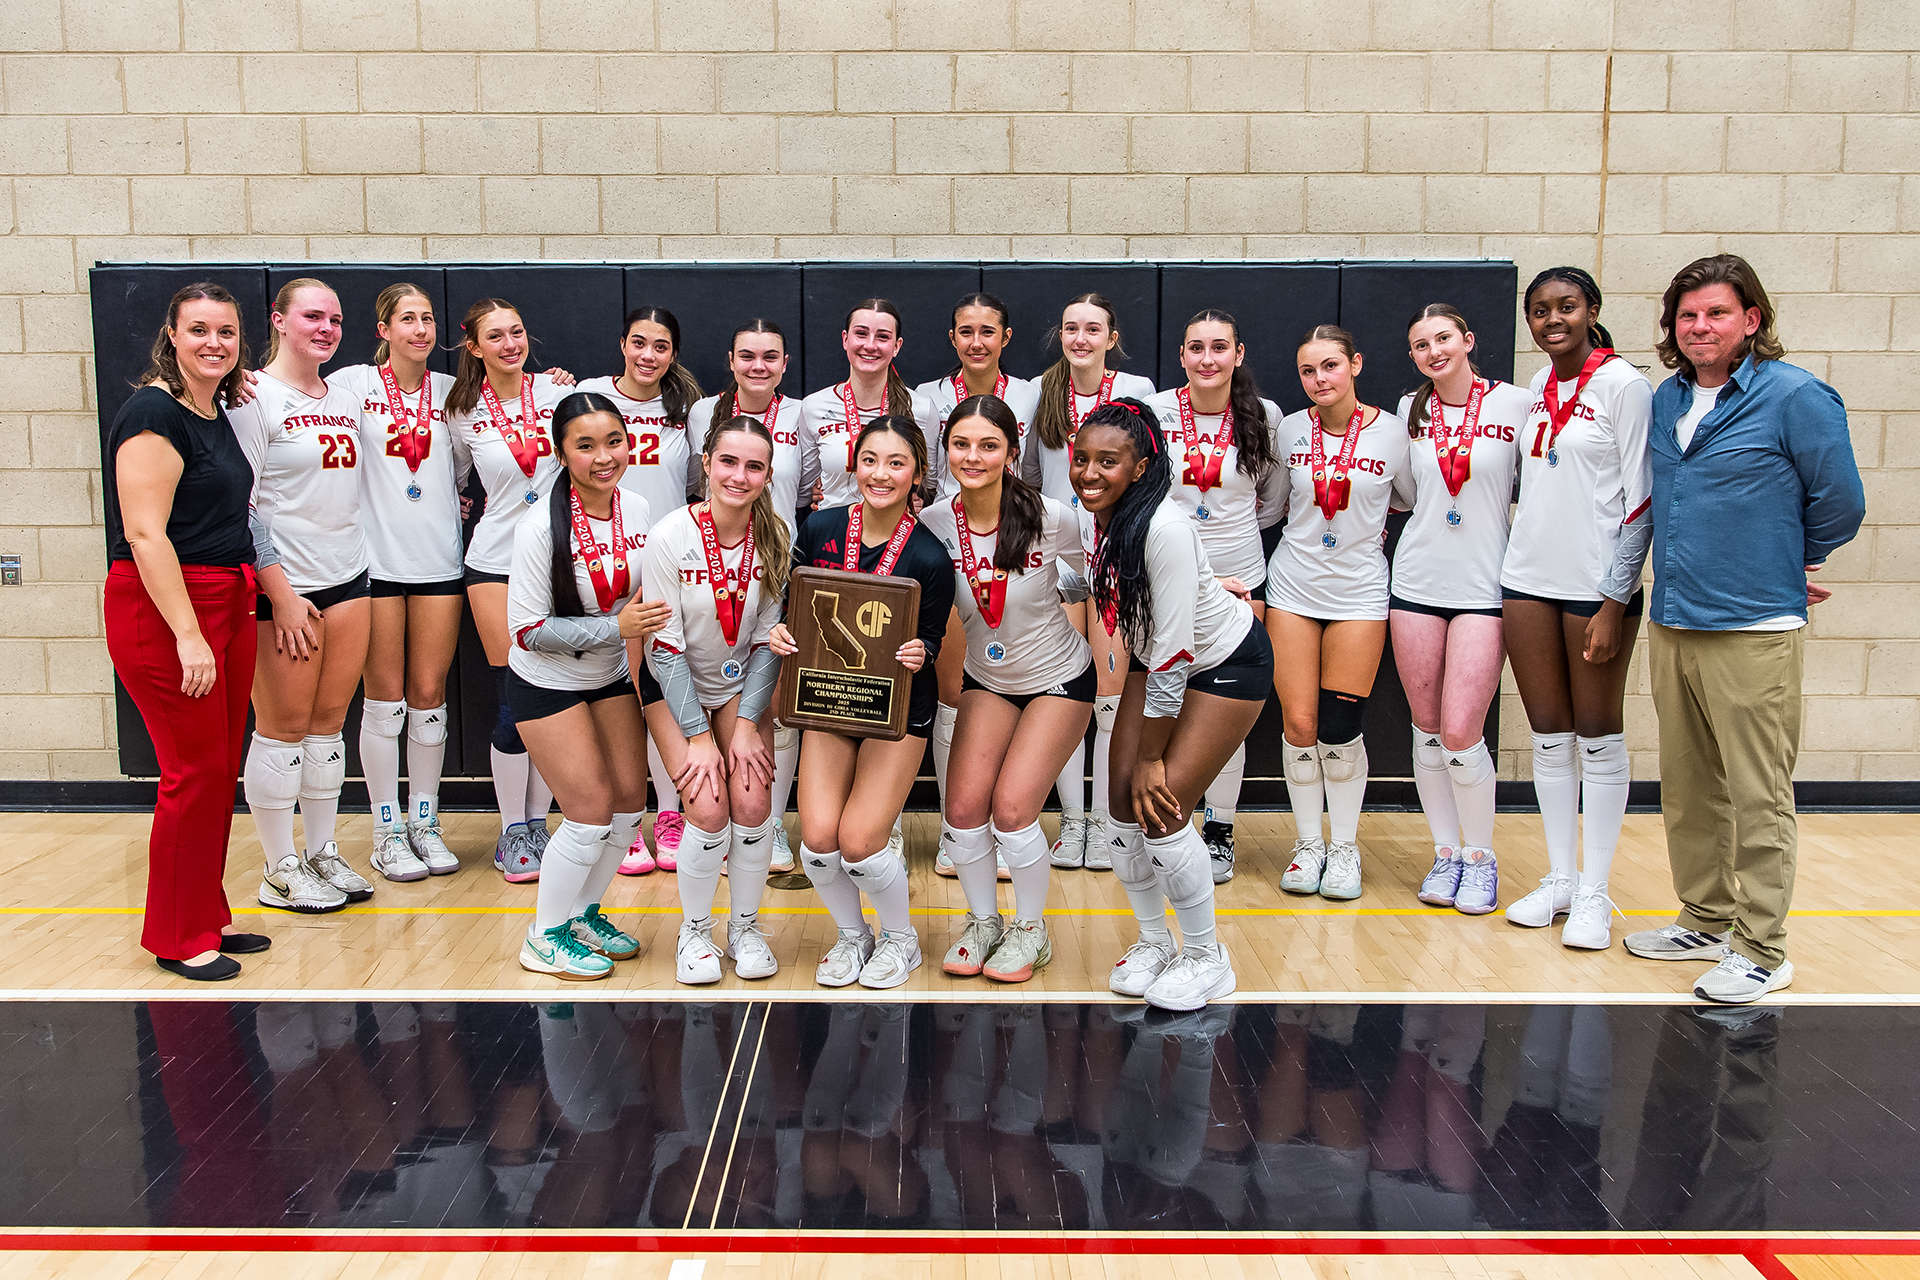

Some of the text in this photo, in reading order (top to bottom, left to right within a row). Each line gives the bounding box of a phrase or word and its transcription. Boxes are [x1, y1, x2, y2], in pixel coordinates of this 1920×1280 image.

[384, 372, 405, 420] 2025-2026
[483, 387, 509, 431] 2025-2026
[845, 388, 860, 436] 2025-2026
[1180, 393, 1196, 442] 2025-2026
[1431, 394, 1446, 443] 2025-2026
[1462, 387, 1482, 440] CHAMPIONSHIPS
[1219, 404, 1235, 443] CHAMPION
[1313, 416, 1323, 466] 2025-2026
[1339, 415, 1361, 466] CHAMPIONSHIPS
[318, 433, 357, 470] 23
[570, 495, 596, 555] 2025-2026
[846, 511, 861, 570] 2025-2026
[877, 519, 912, 577] CHAMPIONSHIPS
[956, 511, 975, 571] 2025-2026
[702, 520, 724, 582] 2025-2026
[855, 600, 893, 638] CIF
[801, 670, 827, 679] California
[827, 673, 863, 684] Interscholastic
[863, 678, 891, 687] Federation
[806, 681, 846, 692] NORTHERN
[846, 685, 884, 697] REGIONAL
[814, 689, 874, 703] CHAMPIONSHIPS
